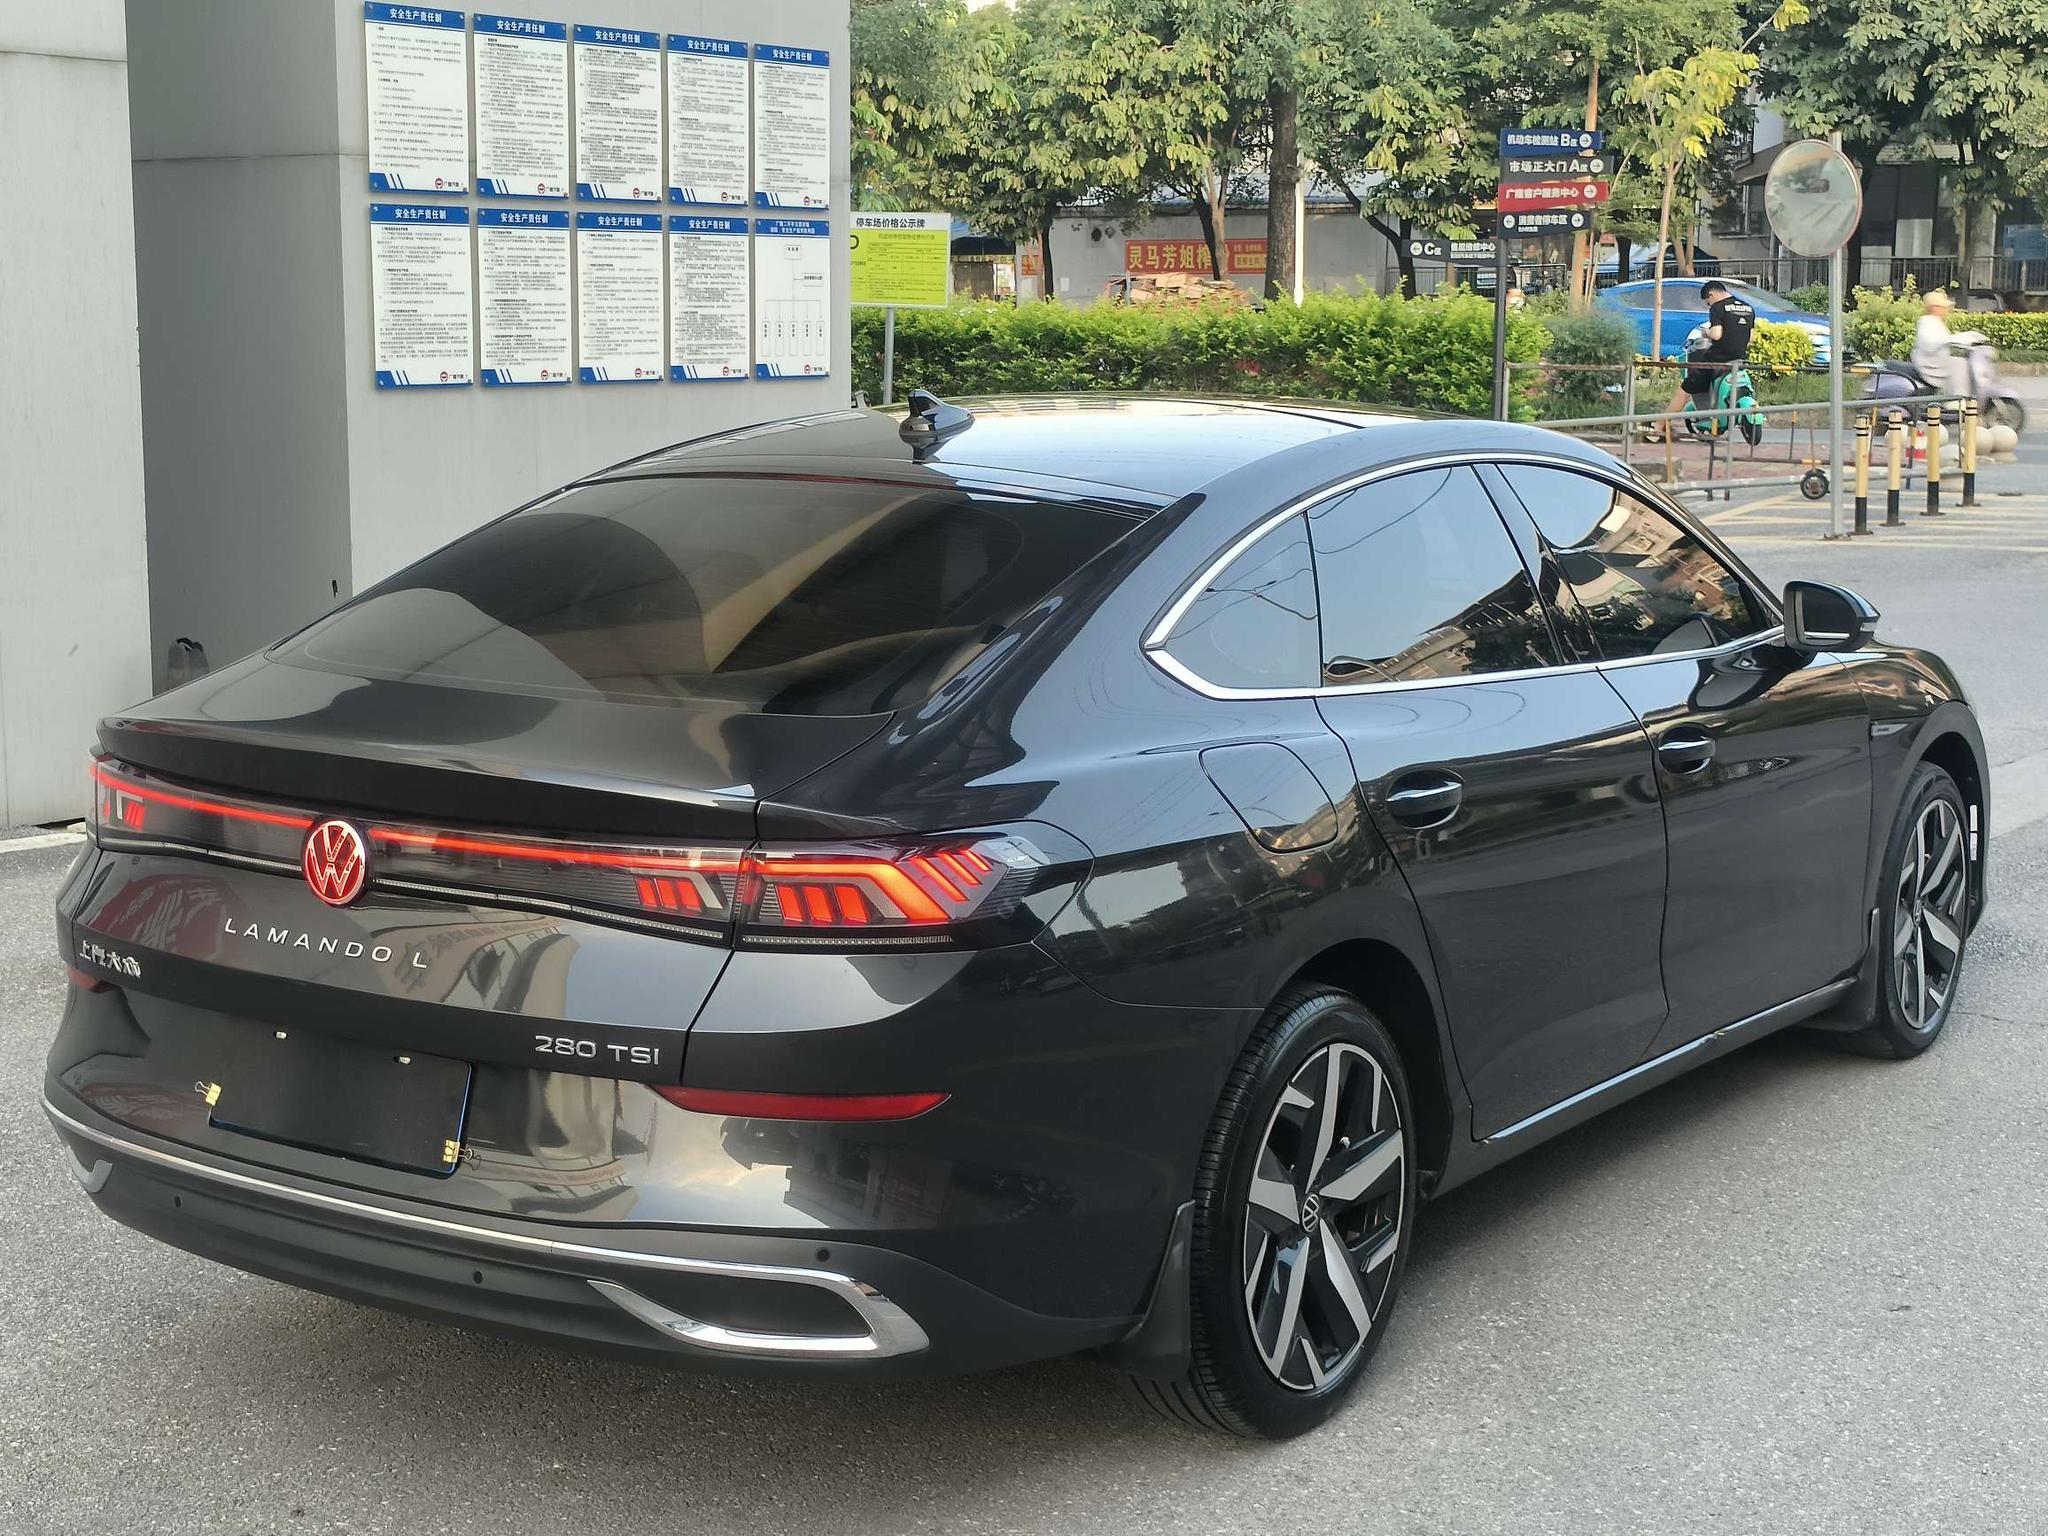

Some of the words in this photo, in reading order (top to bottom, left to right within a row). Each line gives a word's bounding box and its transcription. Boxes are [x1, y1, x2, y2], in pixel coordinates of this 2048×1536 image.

[390, 8, 442, 23] 安全生产责任制
[497, 20, 545, 34] 安全生产责任制
[395, 208, 447, 220] 安全生产责任制
[501, 213, 548, 224] 安全生产责任制
[856, 217, 926, 228] 停车场价格公示牌
[1129, 244, 1229, 270] 灵马芳姐榨
[224, 918, 394, 963] LAMANDO
[412, 951, 428, 969] L
[79, 940, 142, 978] 上汽大众
[535, 1035, 597, 1059] 280
[607, 1044, 660, 1066] TSI
